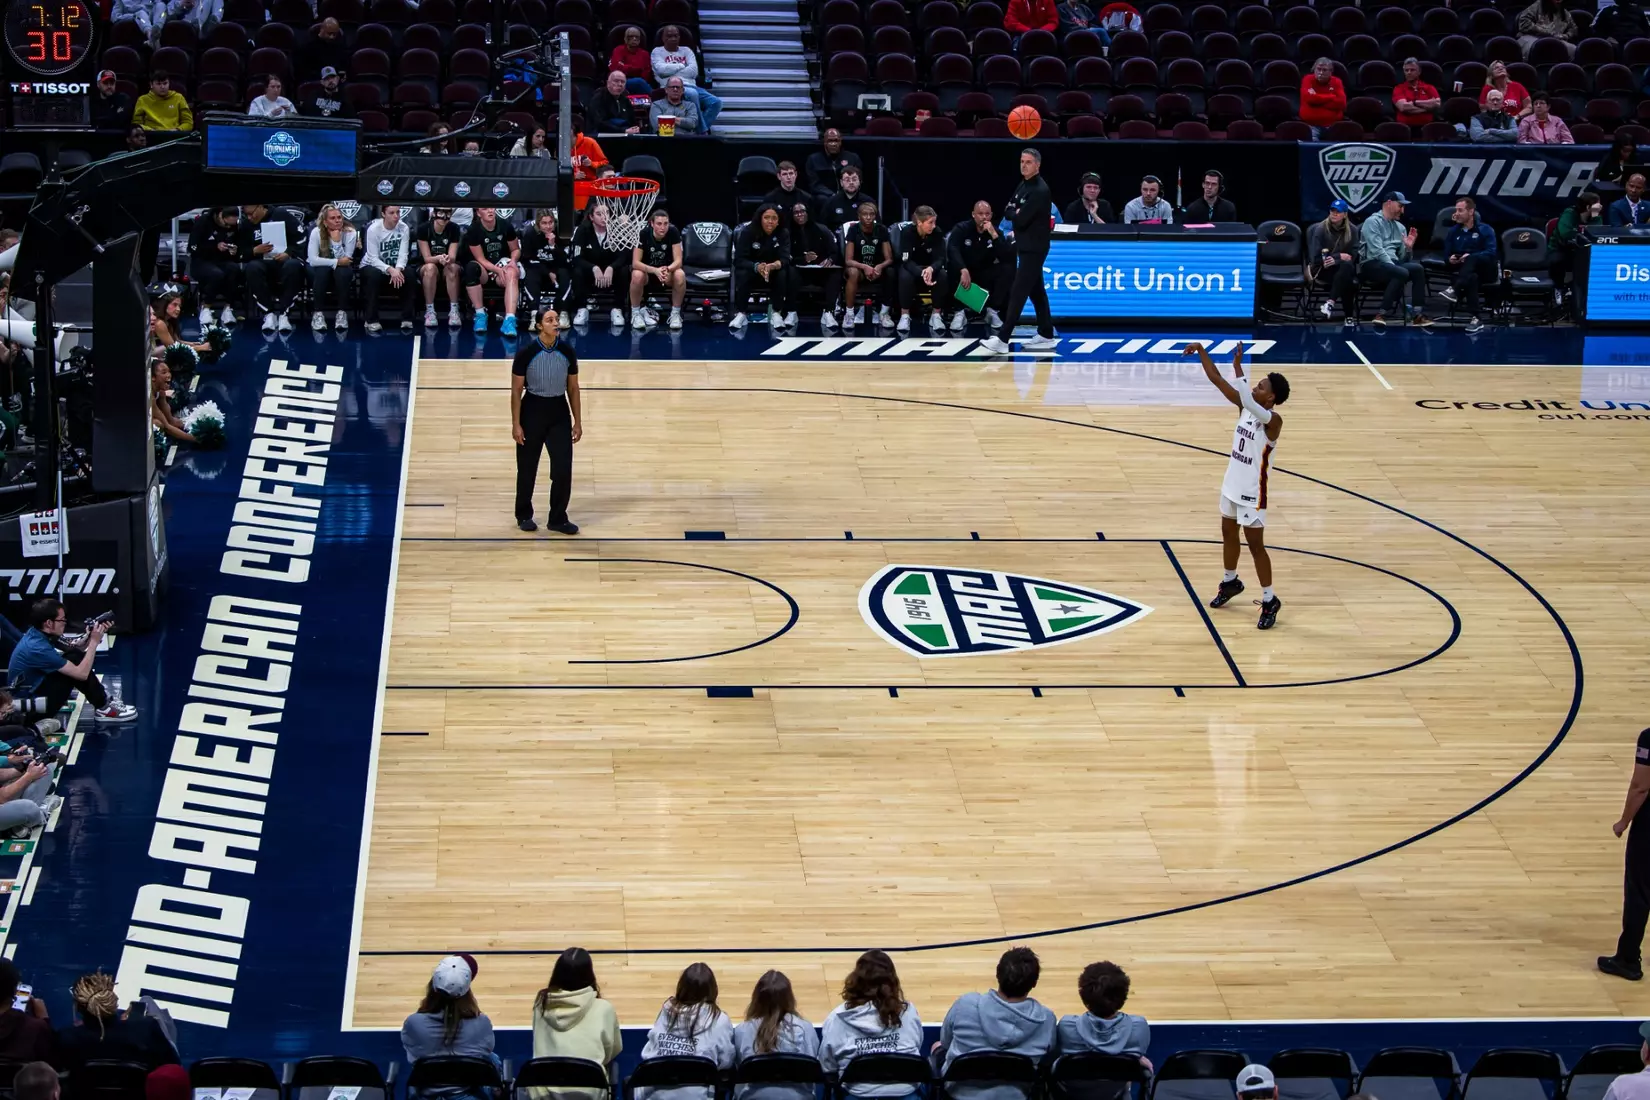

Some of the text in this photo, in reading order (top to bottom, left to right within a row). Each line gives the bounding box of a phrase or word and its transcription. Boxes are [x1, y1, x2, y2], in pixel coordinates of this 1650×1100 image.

[32, 5, 80, 28] 7:12
[27, 31, 71, 60] 30
[33, 83, 90, 94] TISSOT
[1325, 165, 1388, 181] MAC
[696, 227, 721, 235] MAC
[1597, 236, 1619, 244] anc
[1415, 399, 1650, 411] Credit Un
[1238, 437, 1246, 452] 0
[902, 597, 932, 621] 1946
[946, 573, 1034, 647] MAC
[114, 358, 345, 1029] MID-AMERICAN CONFERENCE
[658, 1041, 696, 1053] WATCHES
